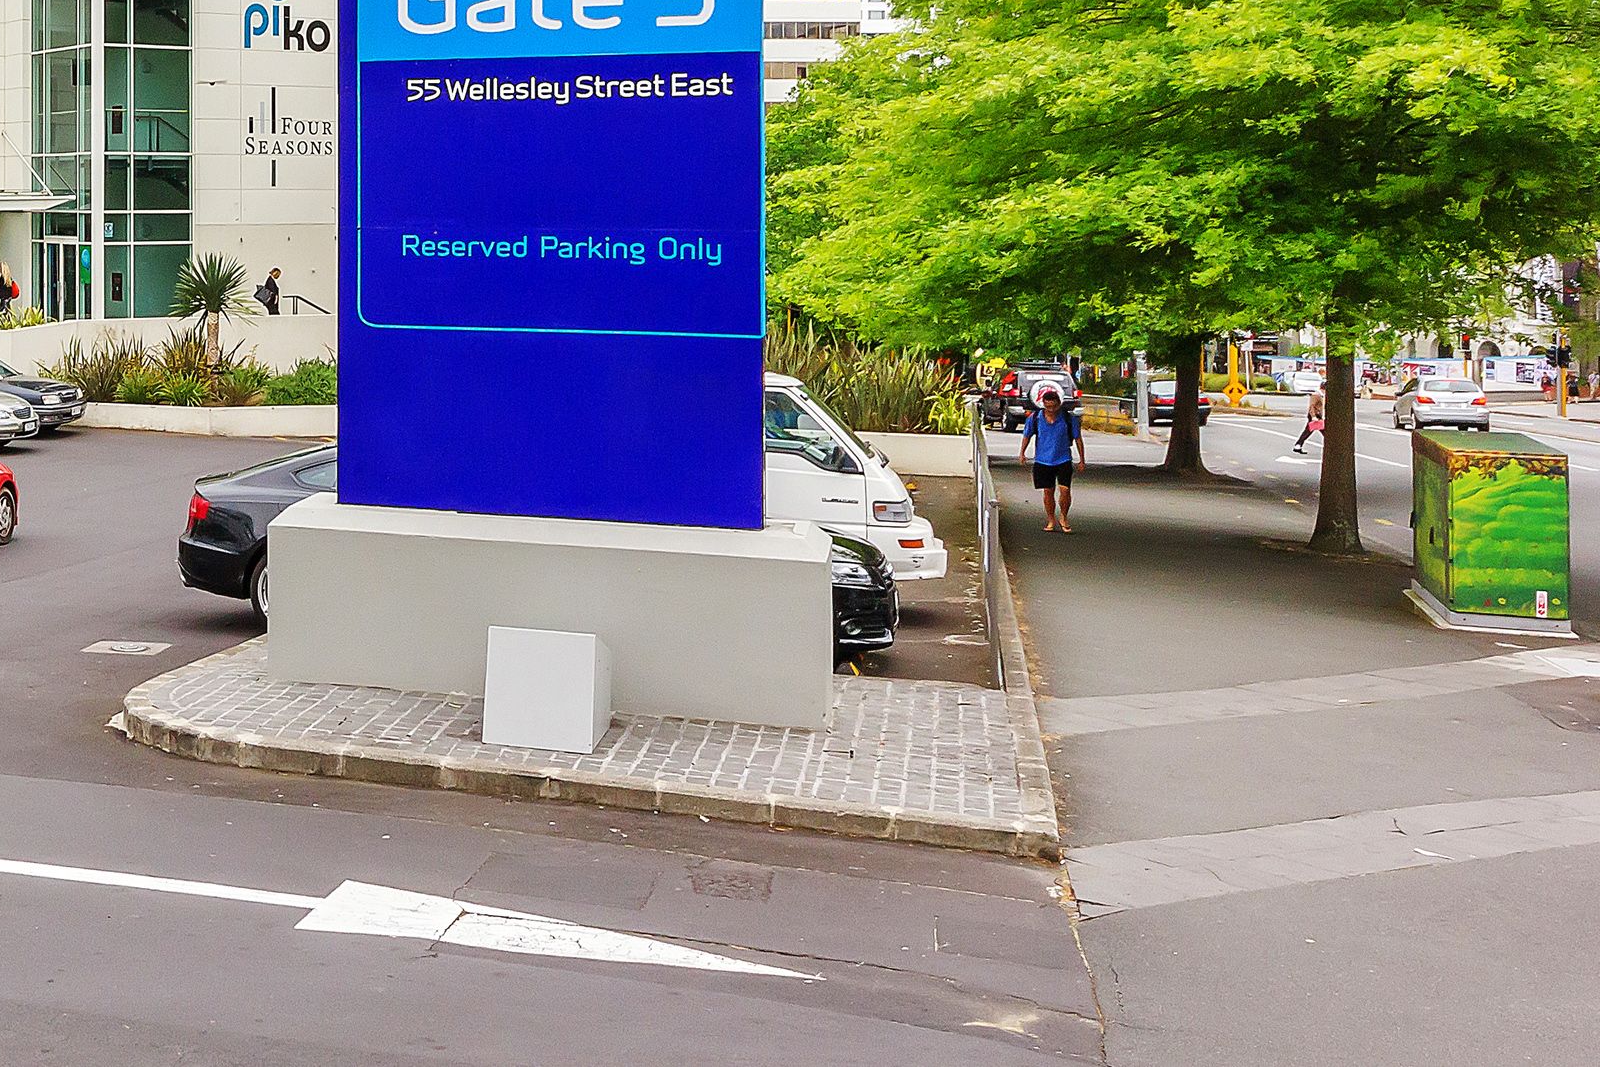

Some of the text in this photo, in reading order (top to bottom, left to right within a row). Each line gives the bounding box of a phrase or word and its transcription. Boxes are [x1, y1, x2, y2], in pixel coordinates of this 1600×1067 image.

[407, 72, 734, 105] 55 Wellesley Street East
[280, 117, 333, 135] FOUR
[244, 136, 333, 156] SEASONS
[402, 231, 722, 267] Reserved Parking Only
